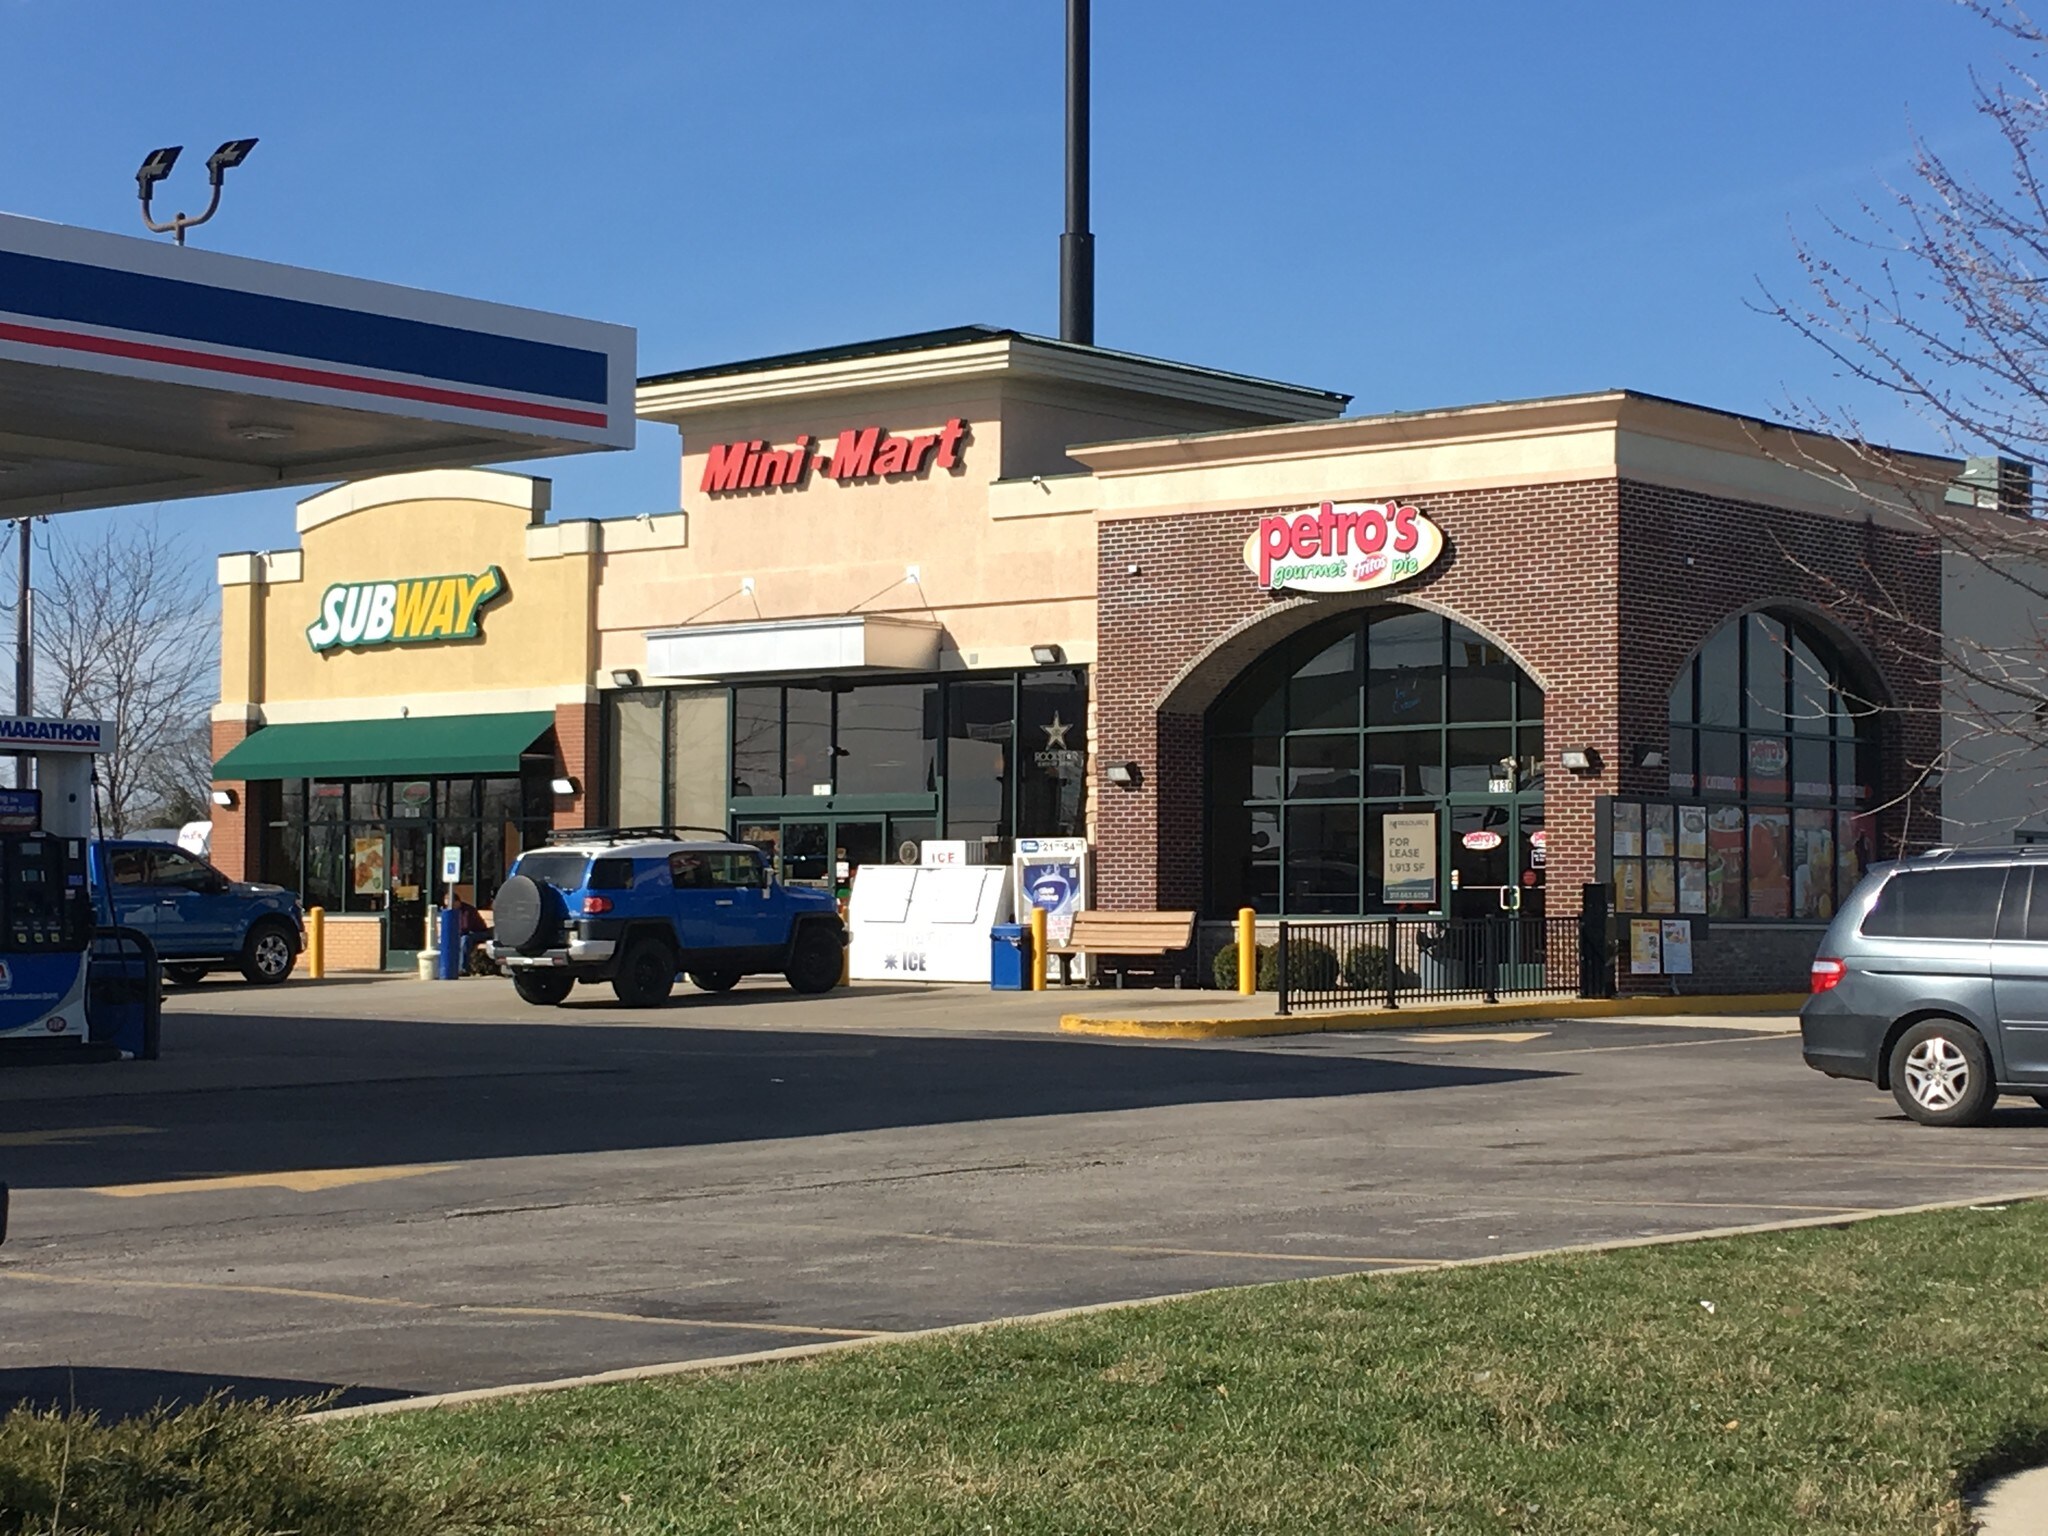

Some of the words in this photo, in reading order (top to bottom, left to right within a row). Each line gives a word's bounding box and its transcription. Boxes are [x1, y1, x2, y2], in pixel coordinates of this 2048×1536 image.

[1259, 500, 1419, 587] petro's
[1273, 559, 1348, 587] gourmet
[1391, 553, 1418, 580] pie
[308, 569, 497, 648] SUBWAY
[0, 720, 100, 742] MARATHON
[1389, 838, 1409, 847] FOR
[931, 852, 955, 864] ICE
[1389, 849, 1420, 858] LEASE
[1389, 863, 1411, 873] 1,913
[1413, 863, 1425, 872] SF
[902, 953, 927, 972] ICE
